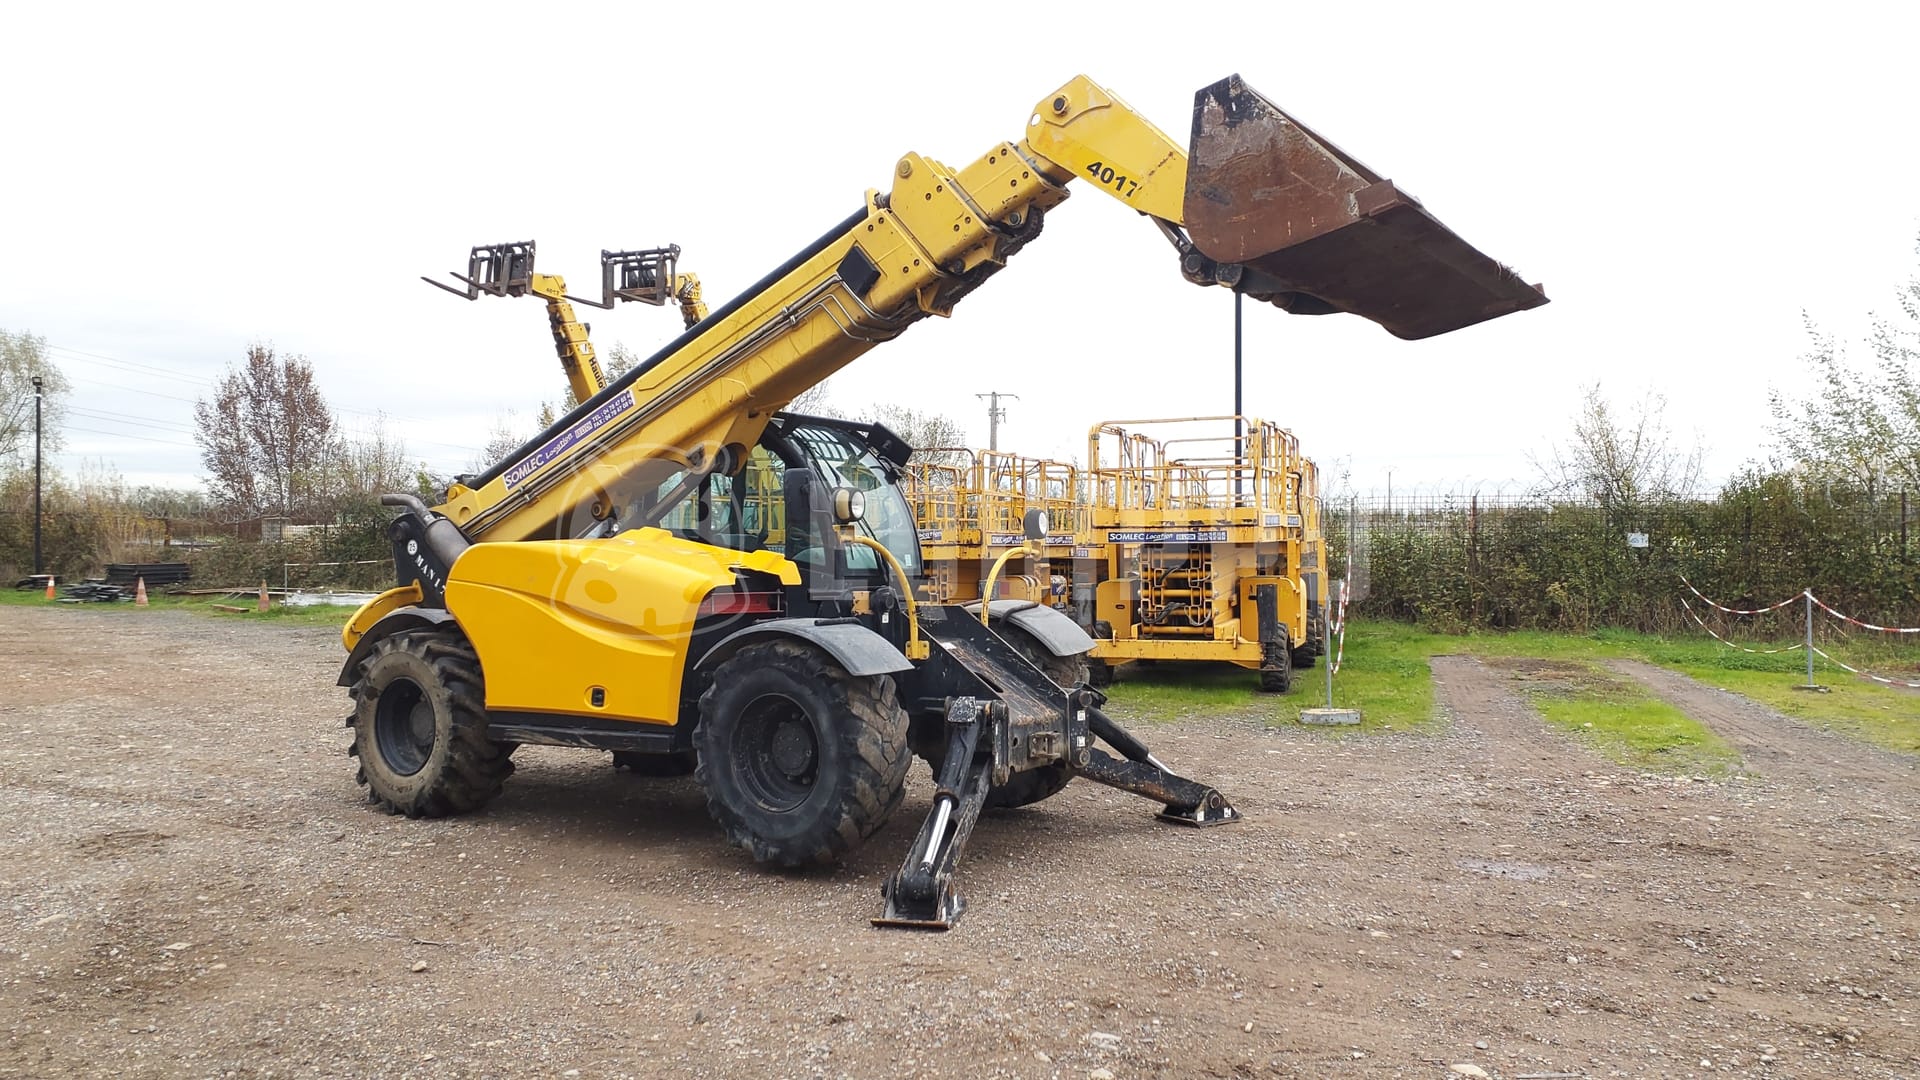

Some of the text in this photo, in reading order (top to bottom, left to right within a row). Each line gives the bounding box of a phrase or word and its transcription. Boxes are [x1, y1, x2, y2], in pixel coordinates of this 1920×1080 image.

[1086, 161, 1142, 197] 4017
[589, 357, 605, 389] Haulo
[505, 433, 573, 487] SOMLEC Location
[1145, 533, 1173, 542] Location
